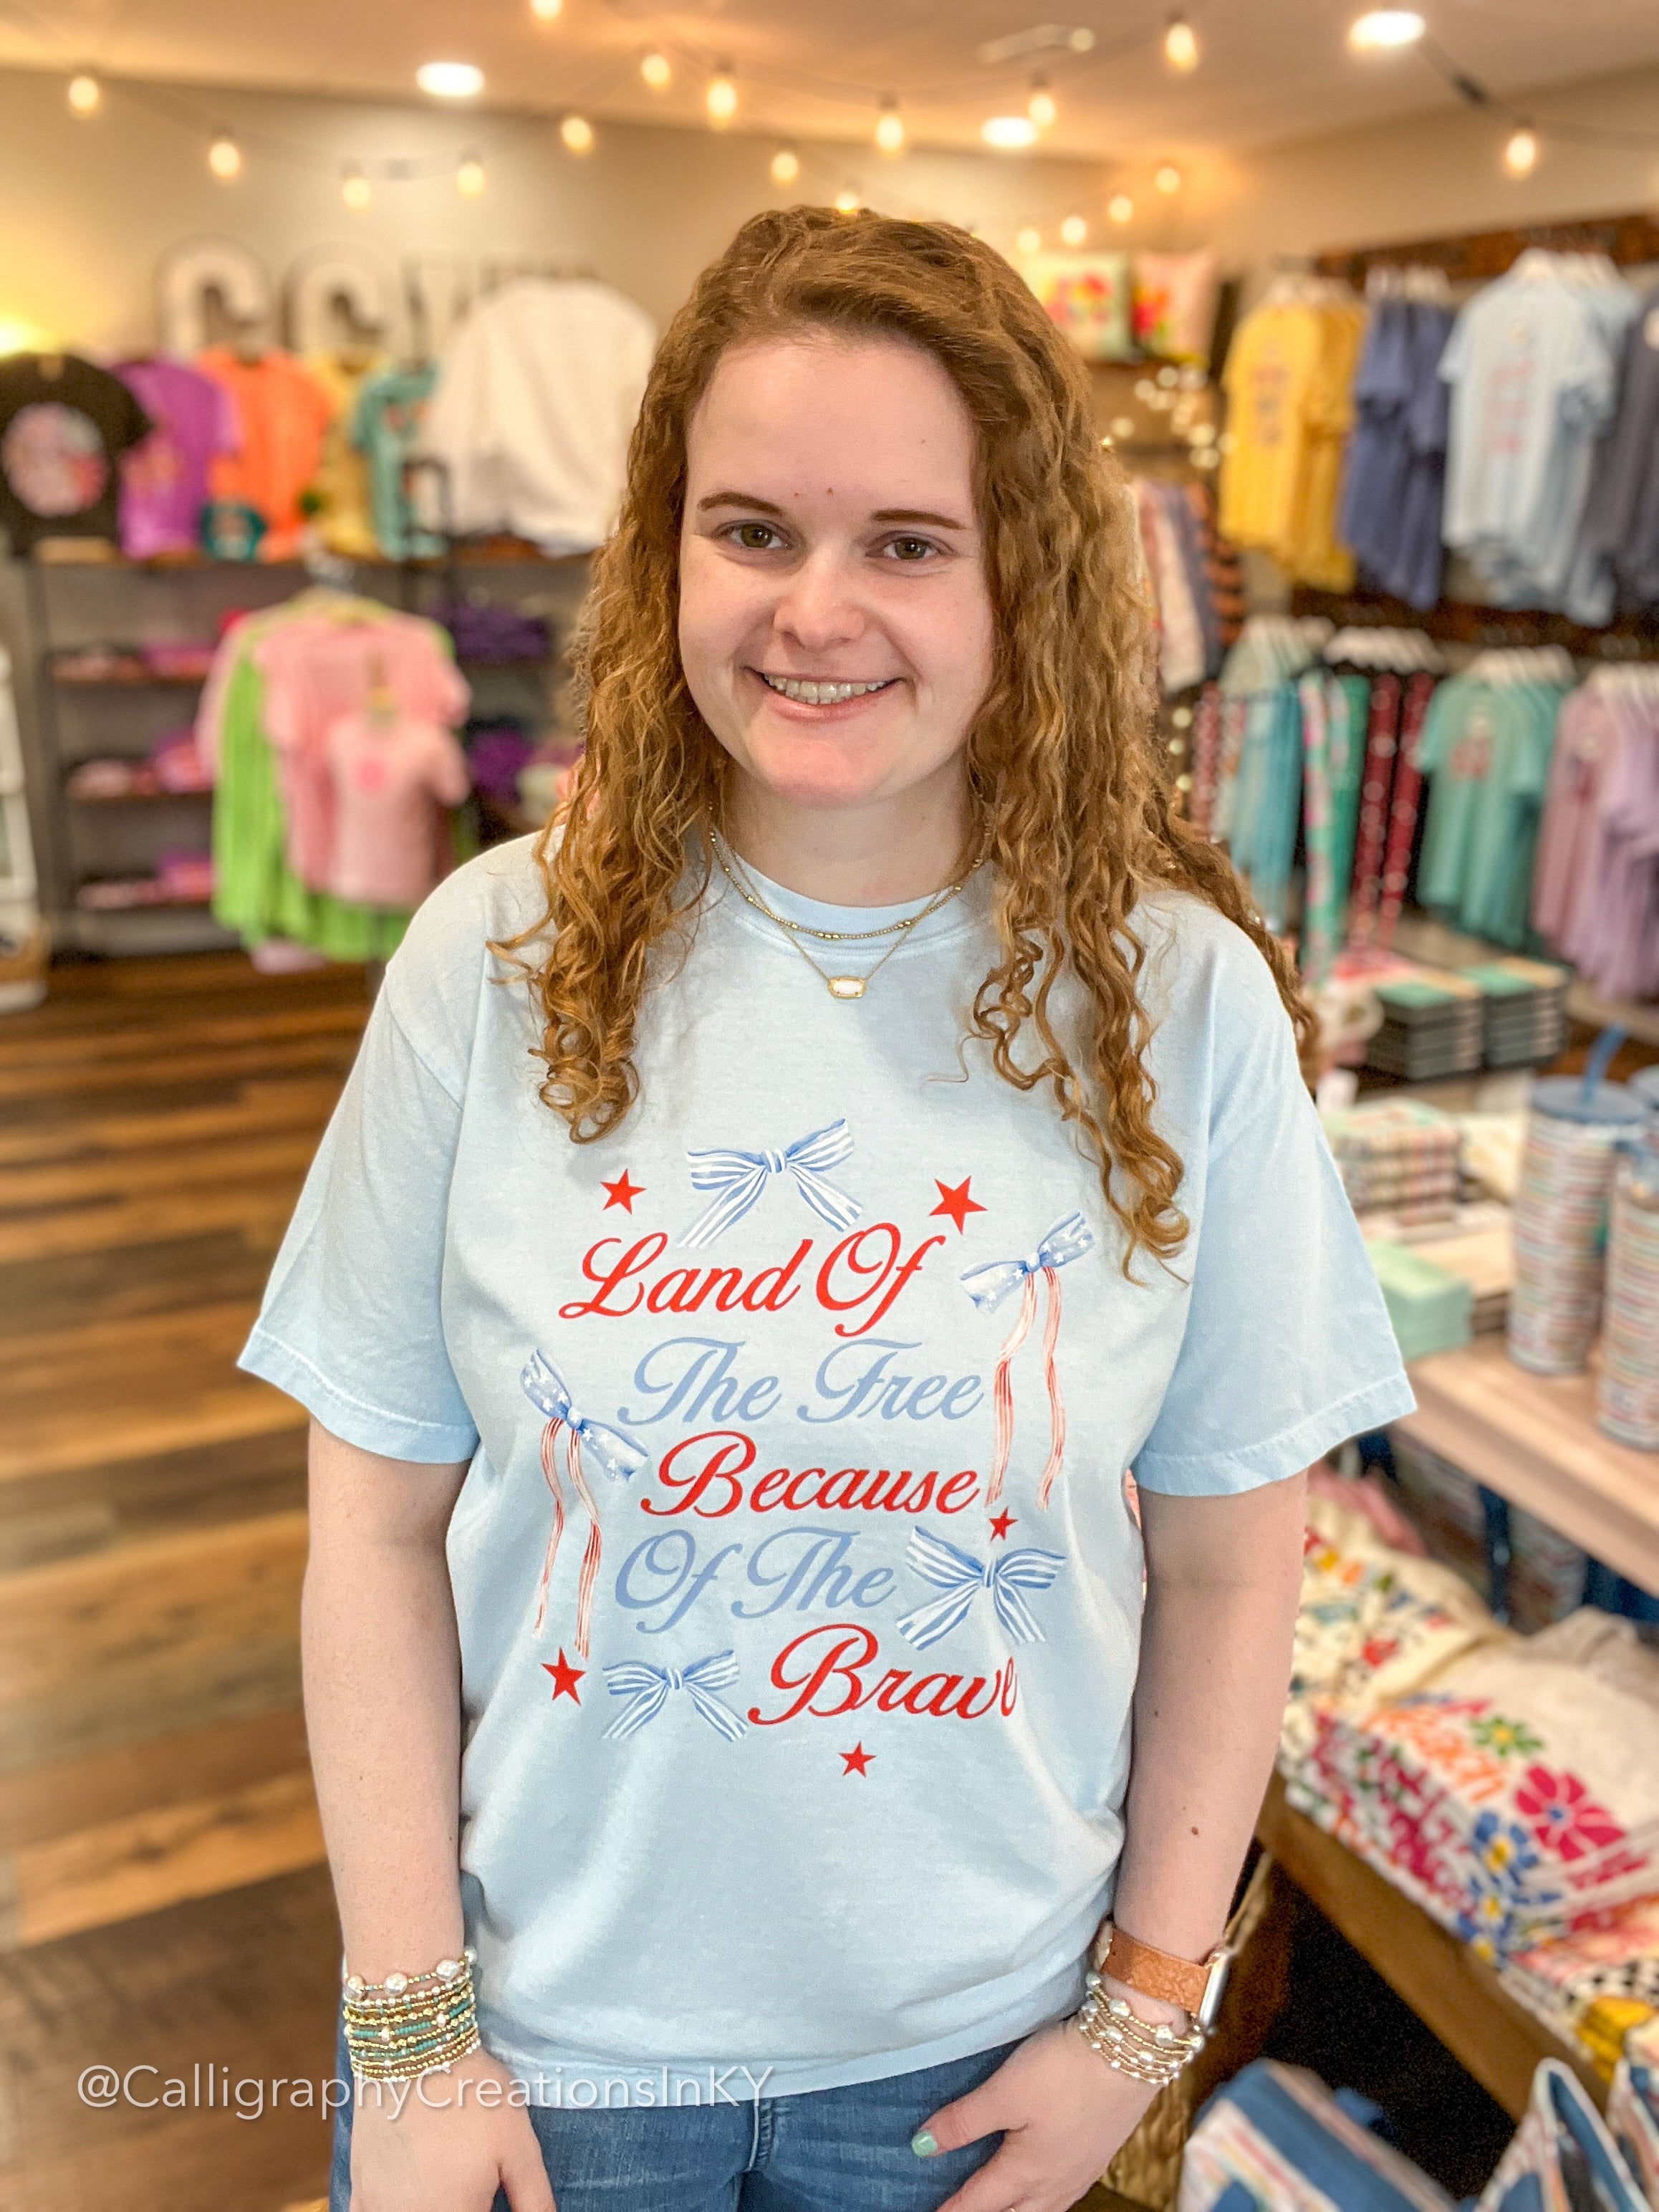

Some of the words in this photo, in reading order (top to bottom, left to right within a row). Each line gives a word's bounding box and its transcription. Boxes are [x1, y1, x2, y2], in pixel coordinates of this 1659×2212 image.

[558, 1231, 814, 1319] Land
[815, 1222, 946, 1338] Of
[616, 1337, 782, 1424] The
[797, 1338, 984, 1423] Free
[640, 1430, 980, 1518] Because
[614, 1529, 742, 1635] Of
[731, 1526, 897, 1620] The
